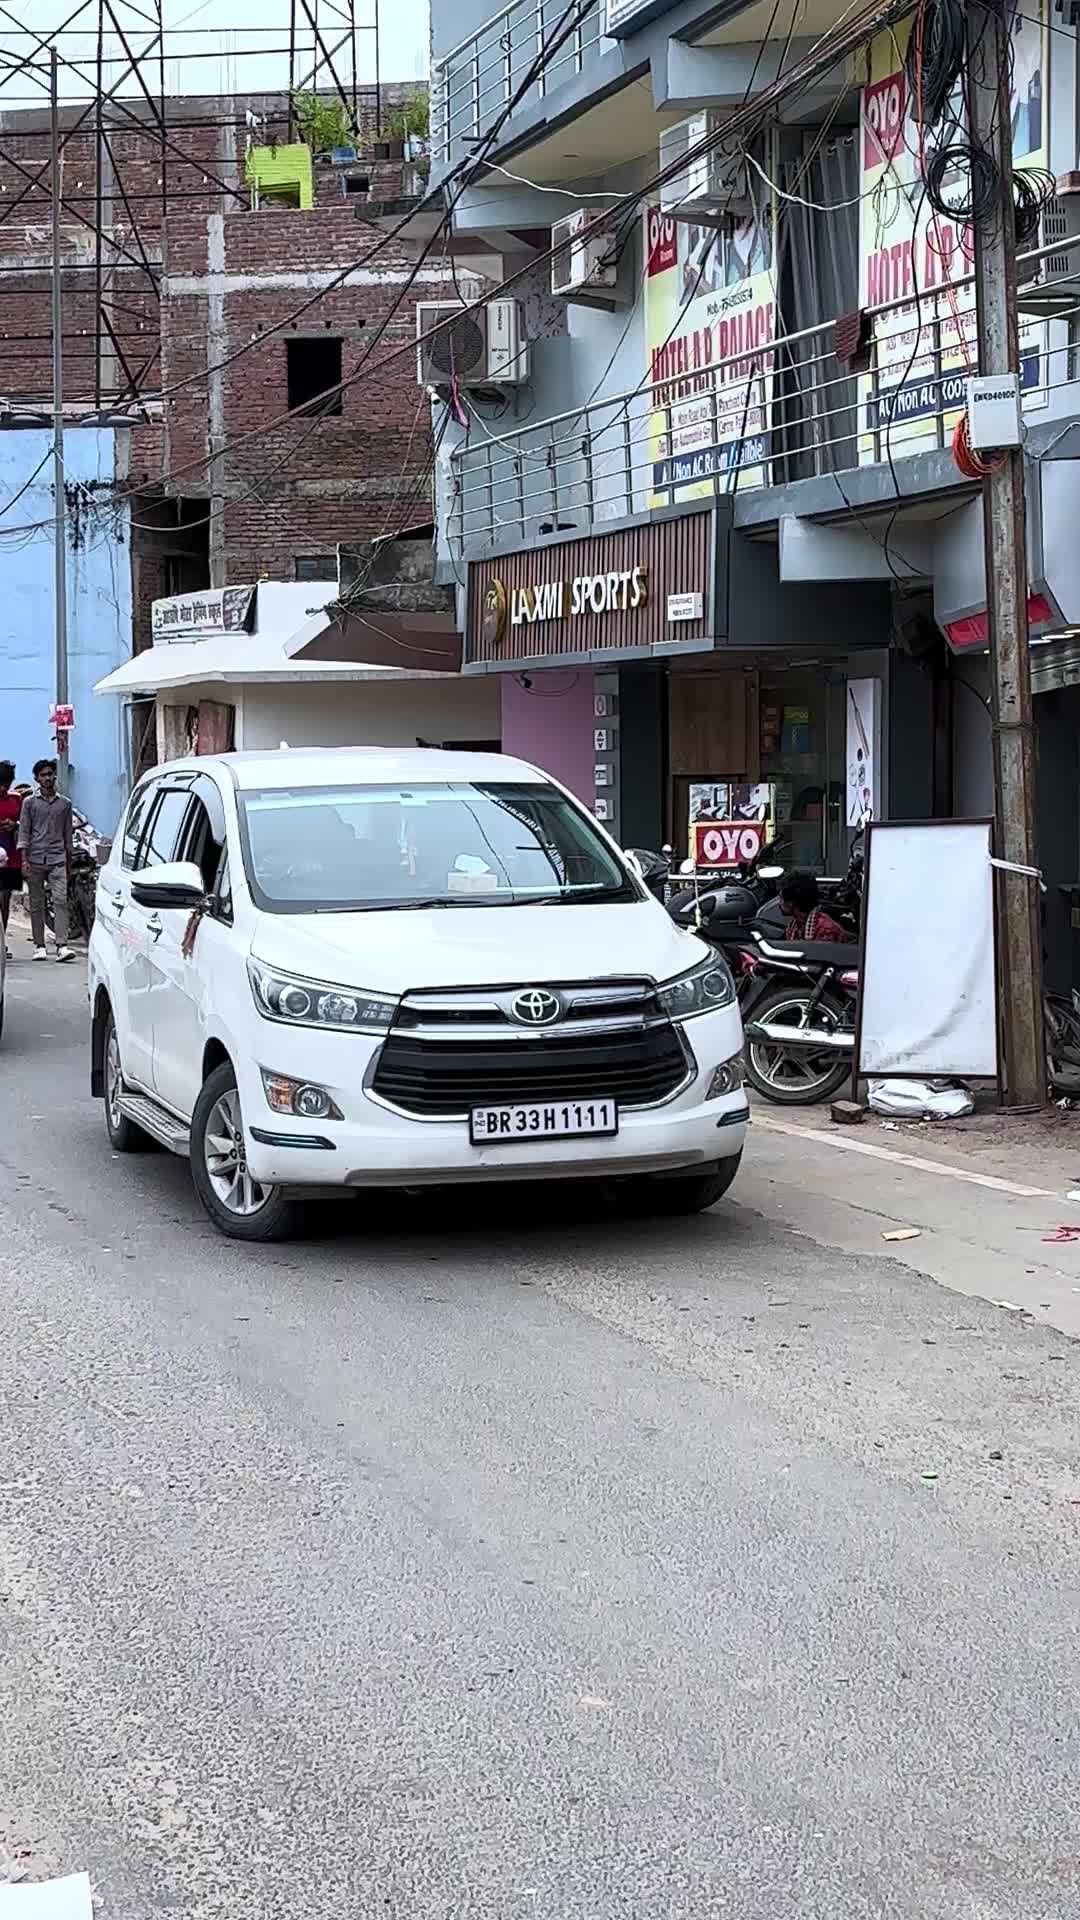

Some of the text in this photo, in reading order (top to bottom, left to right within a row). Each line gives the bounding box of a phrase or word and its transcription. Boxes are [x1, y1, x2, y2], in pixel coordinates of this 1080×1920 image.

[868, 83, 899, 133] OYO
[720, 303, 774, 384] PALACE
[511, 566, 641, 625] LAXMI SPORTS
[703, 829, 760, 861] OYO
